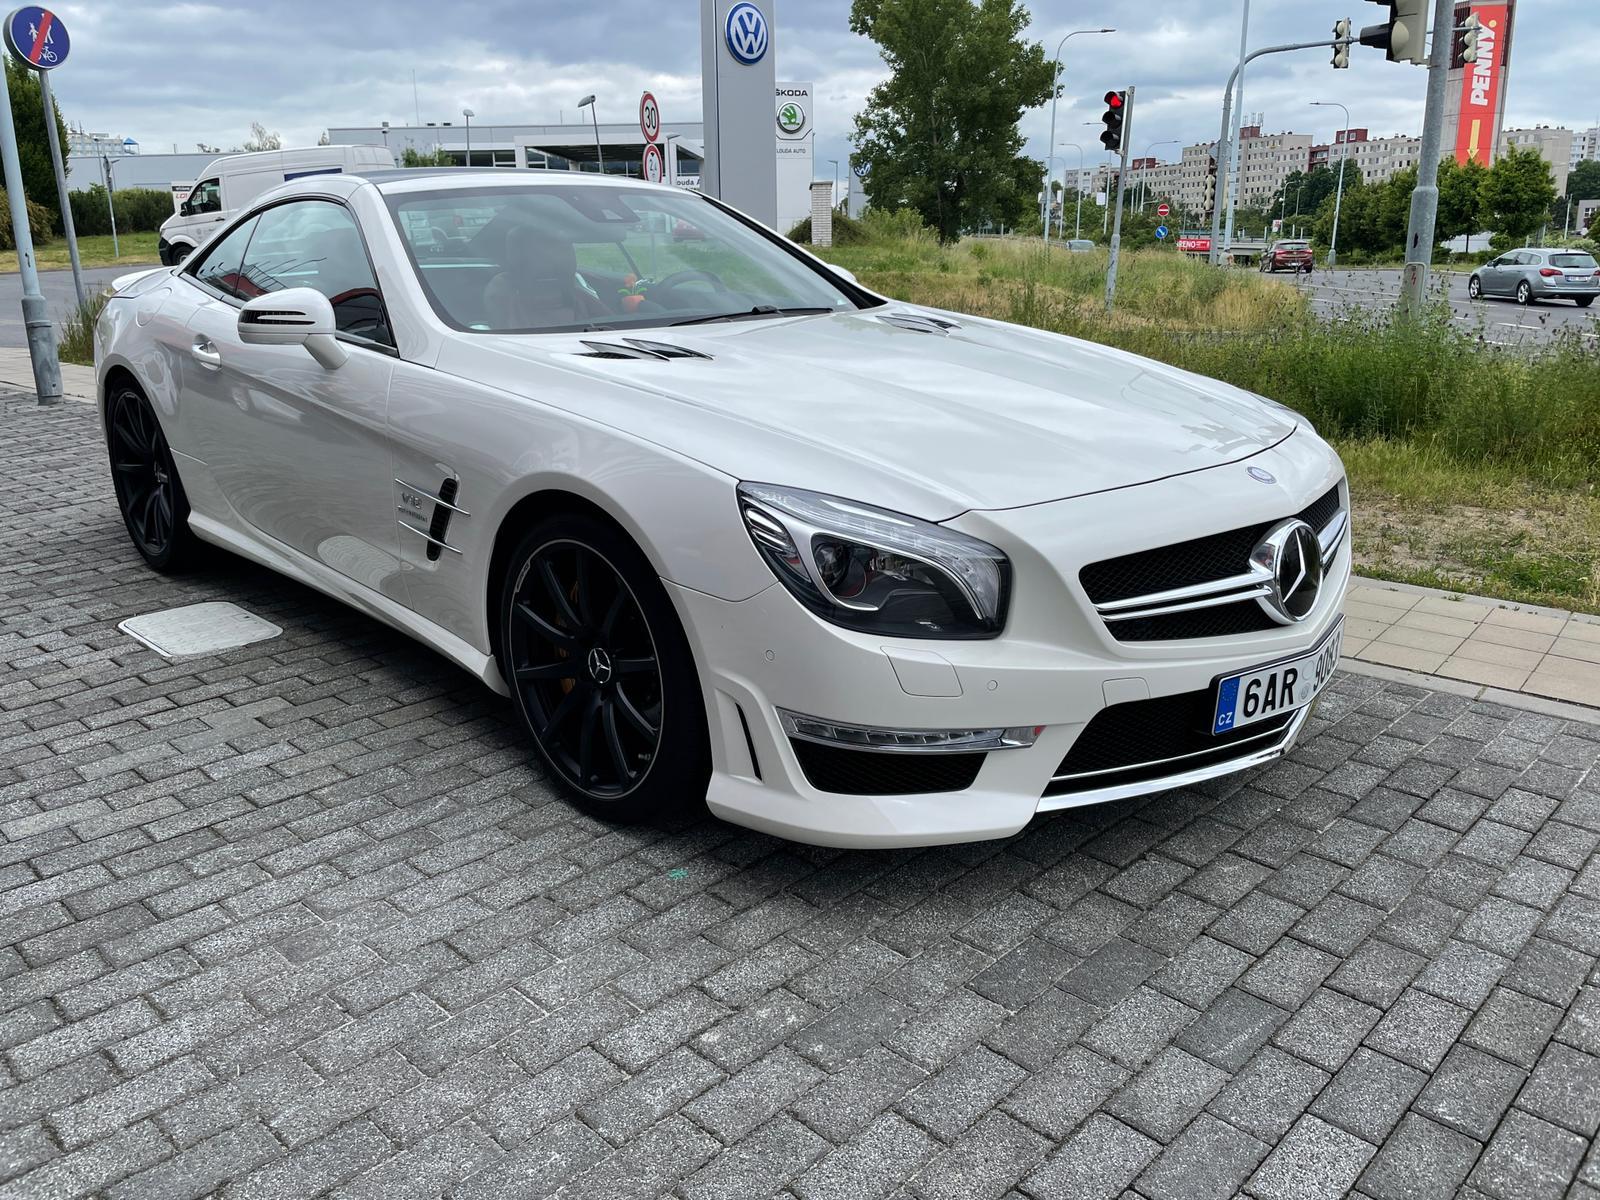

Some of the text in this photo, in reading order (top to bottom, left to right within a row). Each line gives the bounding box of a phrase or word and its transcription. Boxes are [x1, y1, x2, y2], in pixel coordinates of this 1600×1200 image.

[644, 106, 656, 129] 30
[1243, 667, 1298, 718] 6AR
[1218, 711, 1232, 726] CZ
